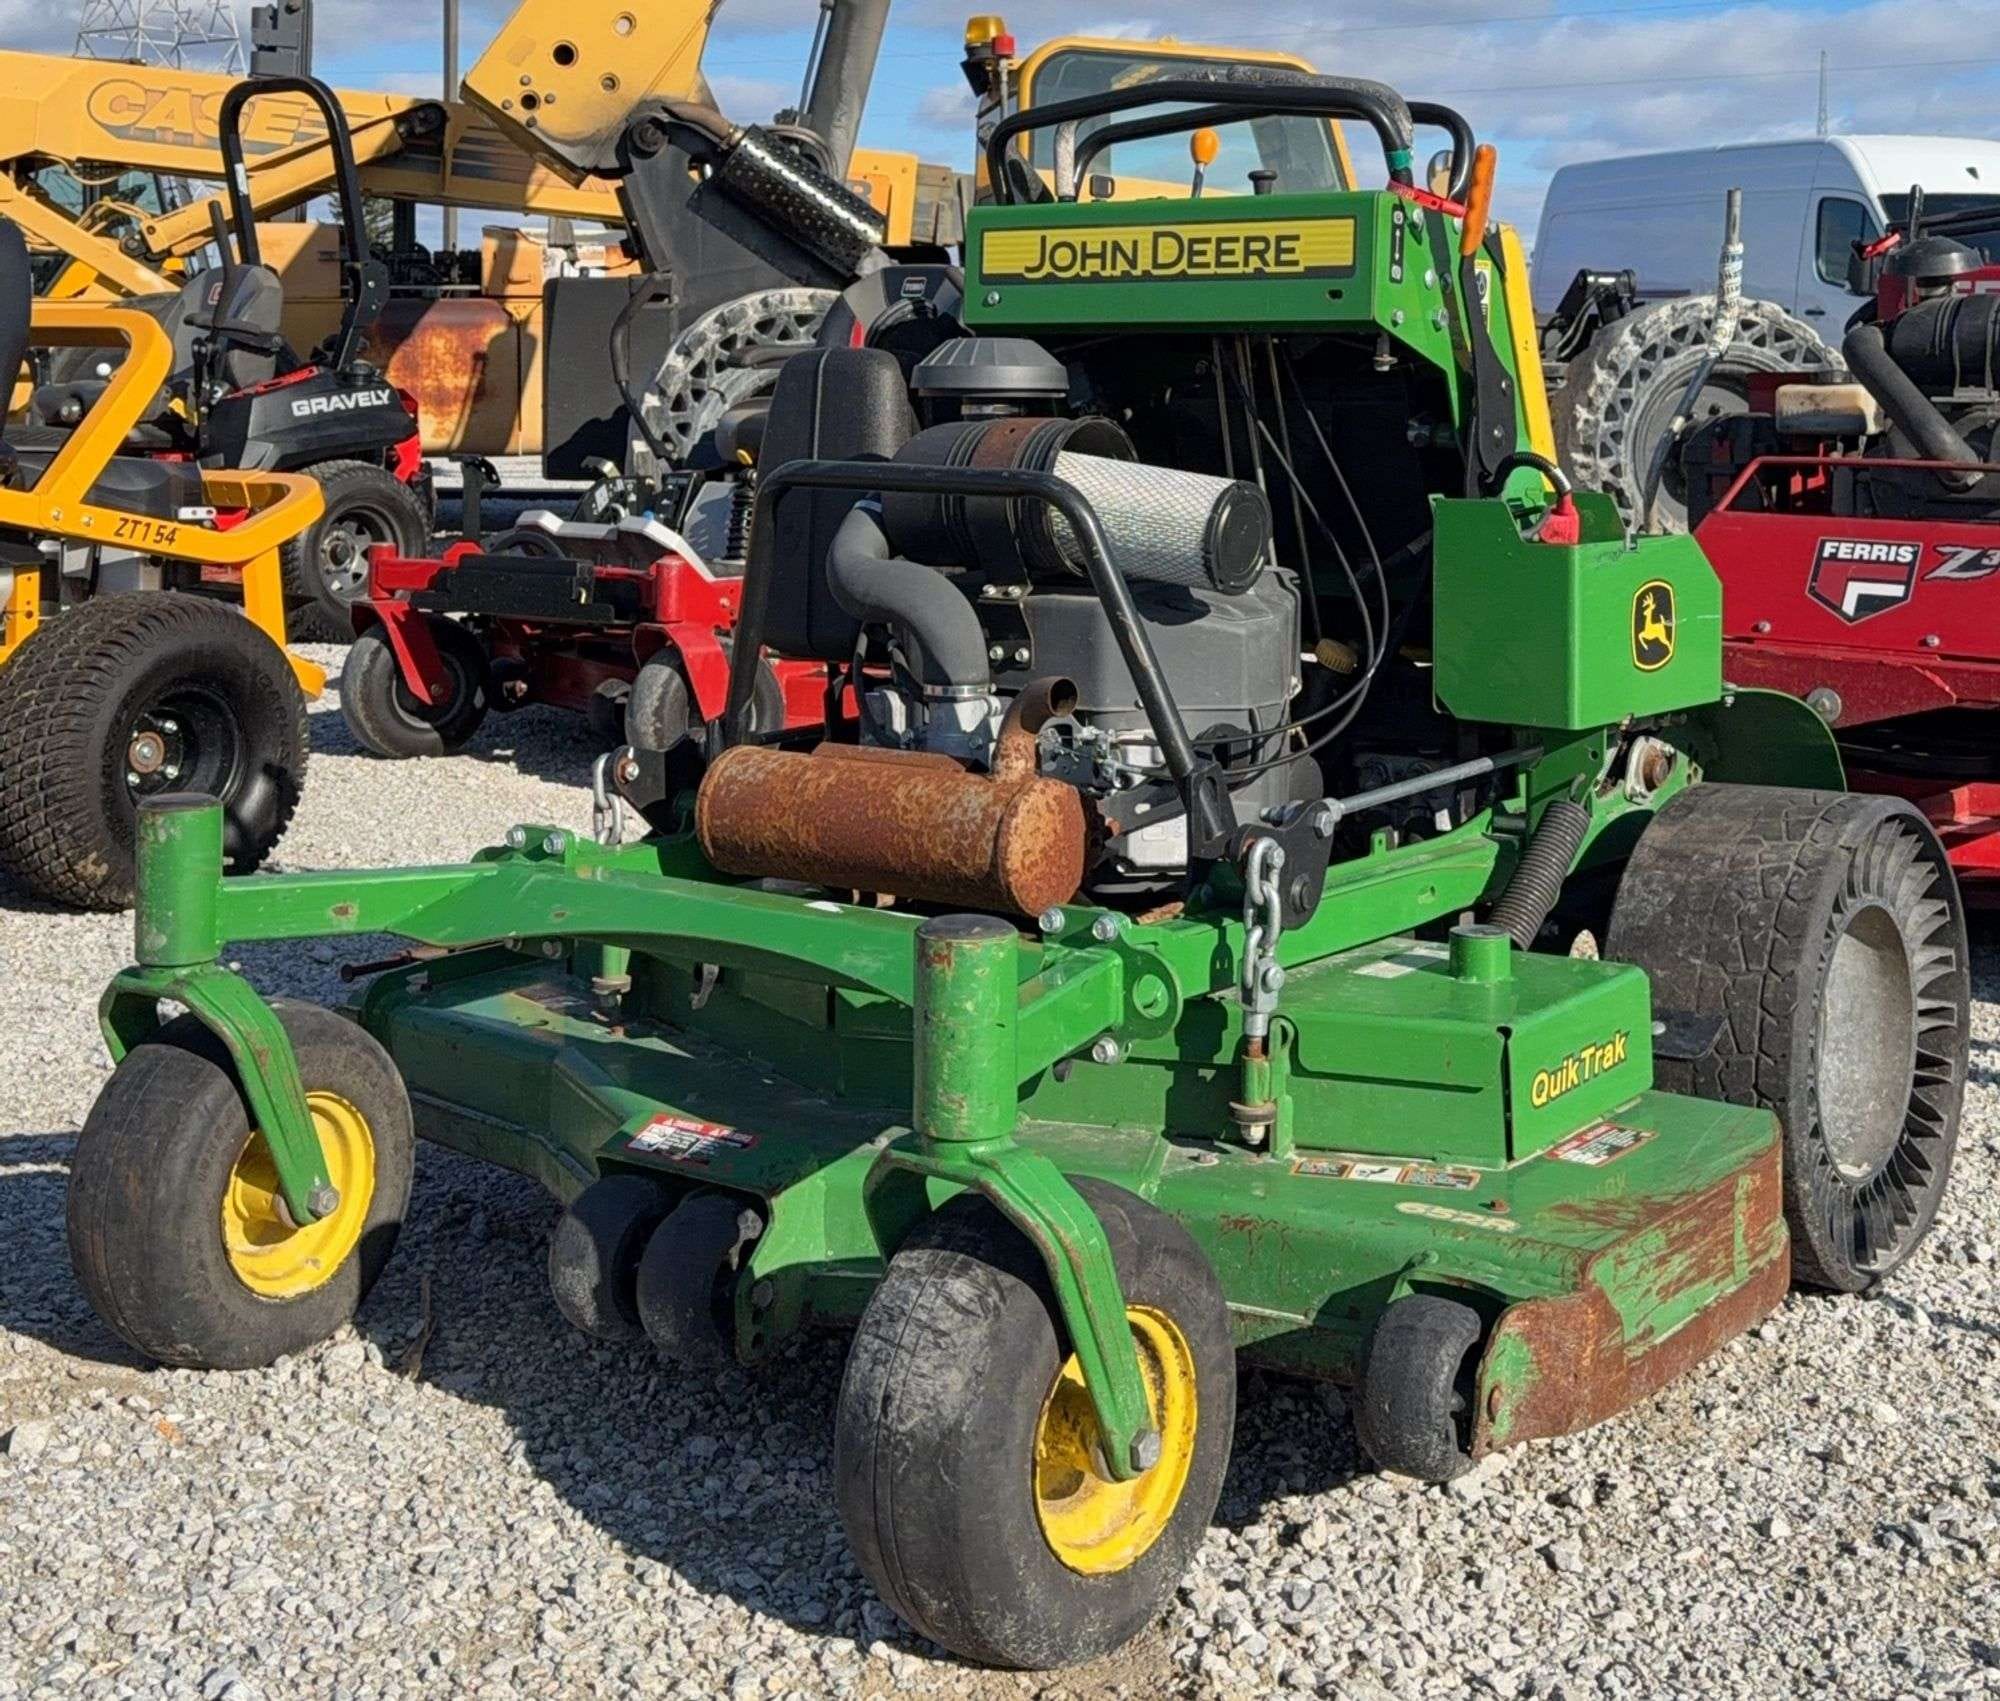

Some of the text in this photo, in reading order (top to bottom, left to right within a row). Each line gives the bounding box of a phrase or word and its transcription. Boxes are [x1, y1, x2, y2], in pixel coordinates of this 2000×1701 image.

[87, 79, 307, 148] CASE
[1024, 230, 1301, 275] JOHN DEERE
[291, 388, 390, 417] GRAVELY
[1822, 541, 1914, 563] FERRIS
